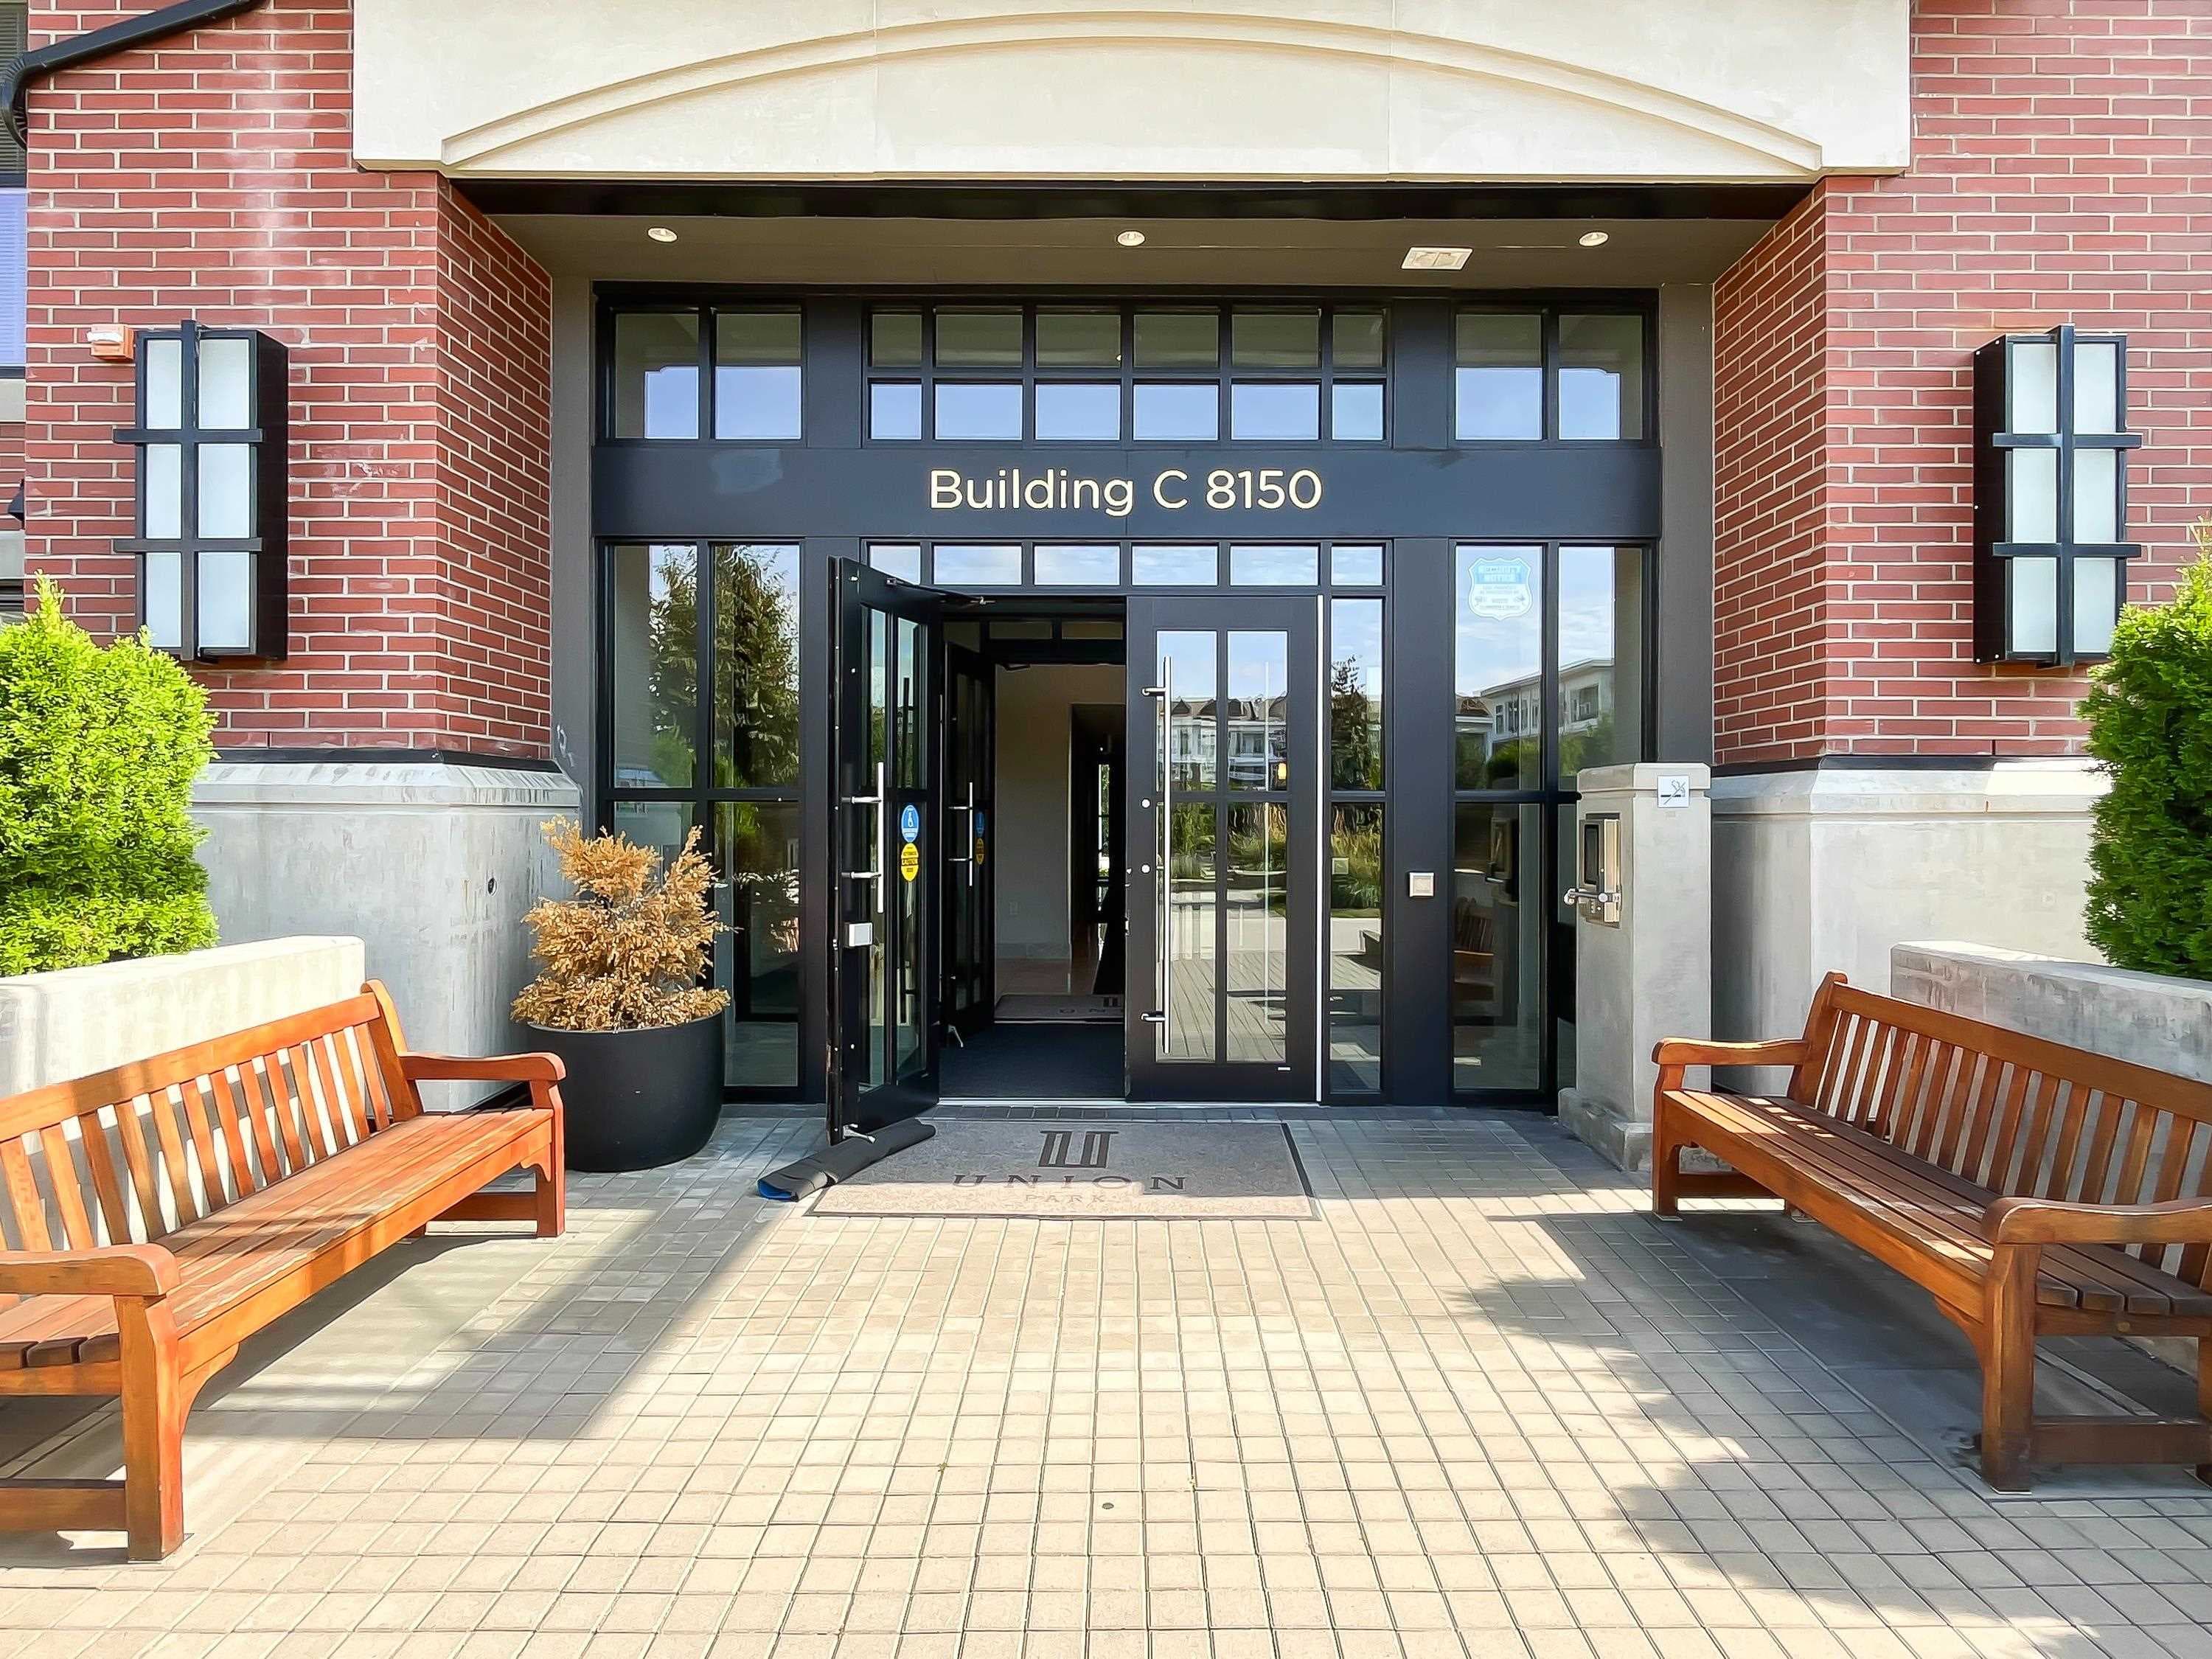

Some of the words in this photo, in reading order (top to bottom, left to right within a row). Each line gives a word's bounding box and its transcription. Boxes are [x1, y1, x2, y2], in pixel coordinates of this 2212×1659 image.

[931, 468, 1134, 517] Building
[1152, 469, 1189, 509] C
[1206, 469, 1323, 509] 8150
[952, 1175, 1186, 1190] UNION
[1026, 1194, 1105, 1203] PARK
